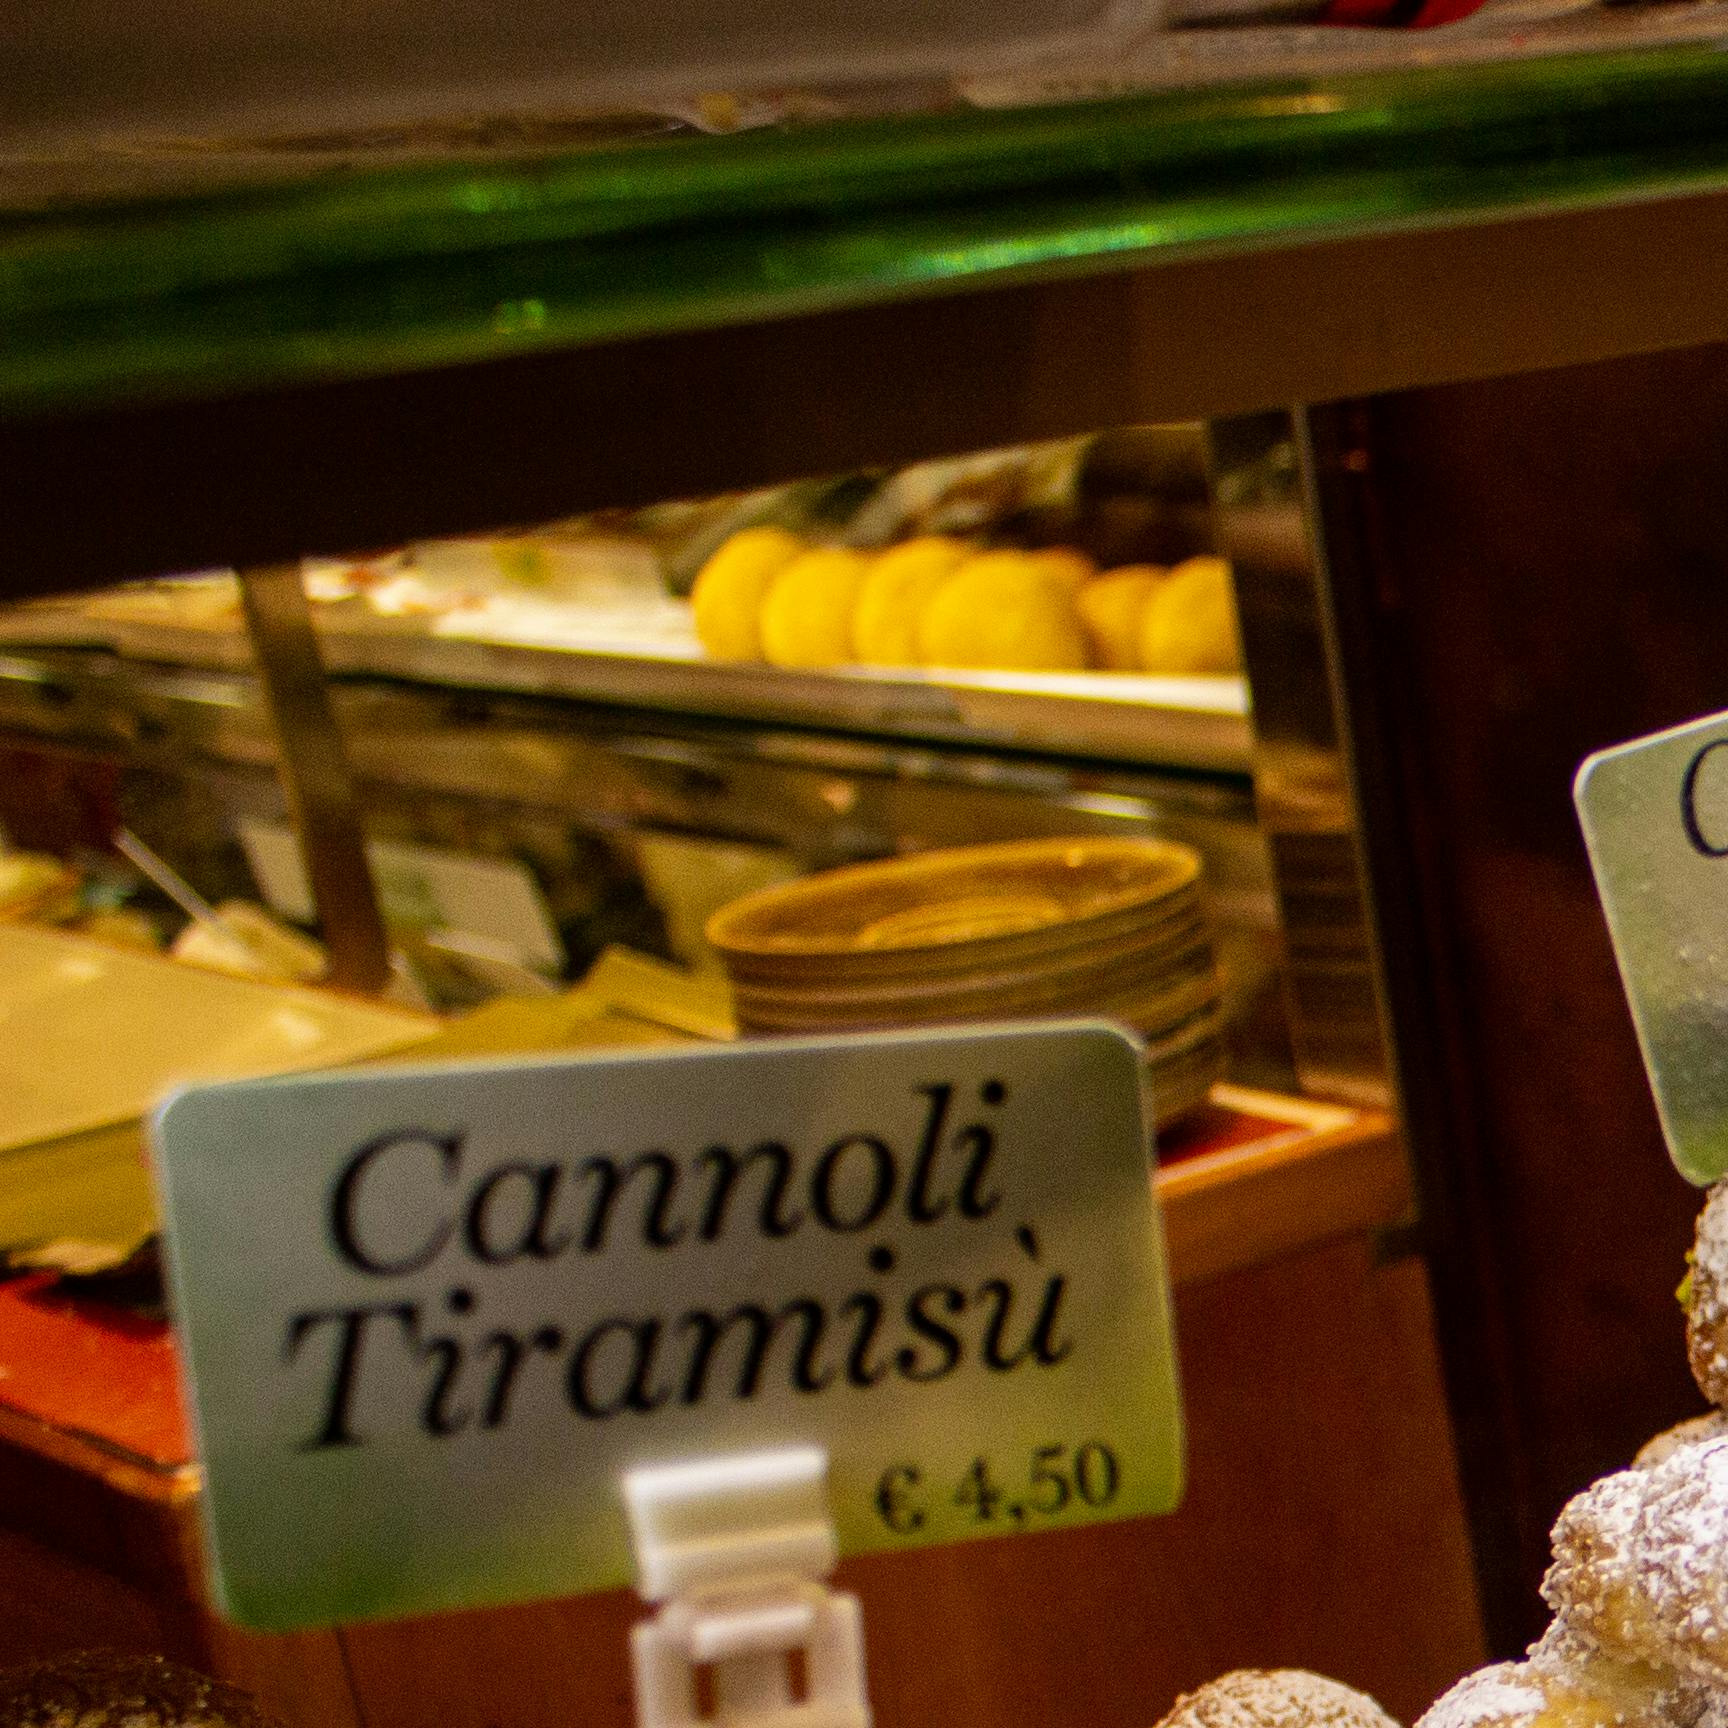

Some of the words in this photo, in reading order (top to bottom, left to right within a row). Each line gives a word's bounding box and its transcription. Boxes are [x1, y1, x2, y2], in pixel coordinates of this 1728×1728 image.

[327, 1077, 1012, 1279] Cannoli
[285, 1221, 1072, 1453] Tiramisù
[876, 1464, 926, 1534] €
[953, 1439, 1121, 1532] 4,50
